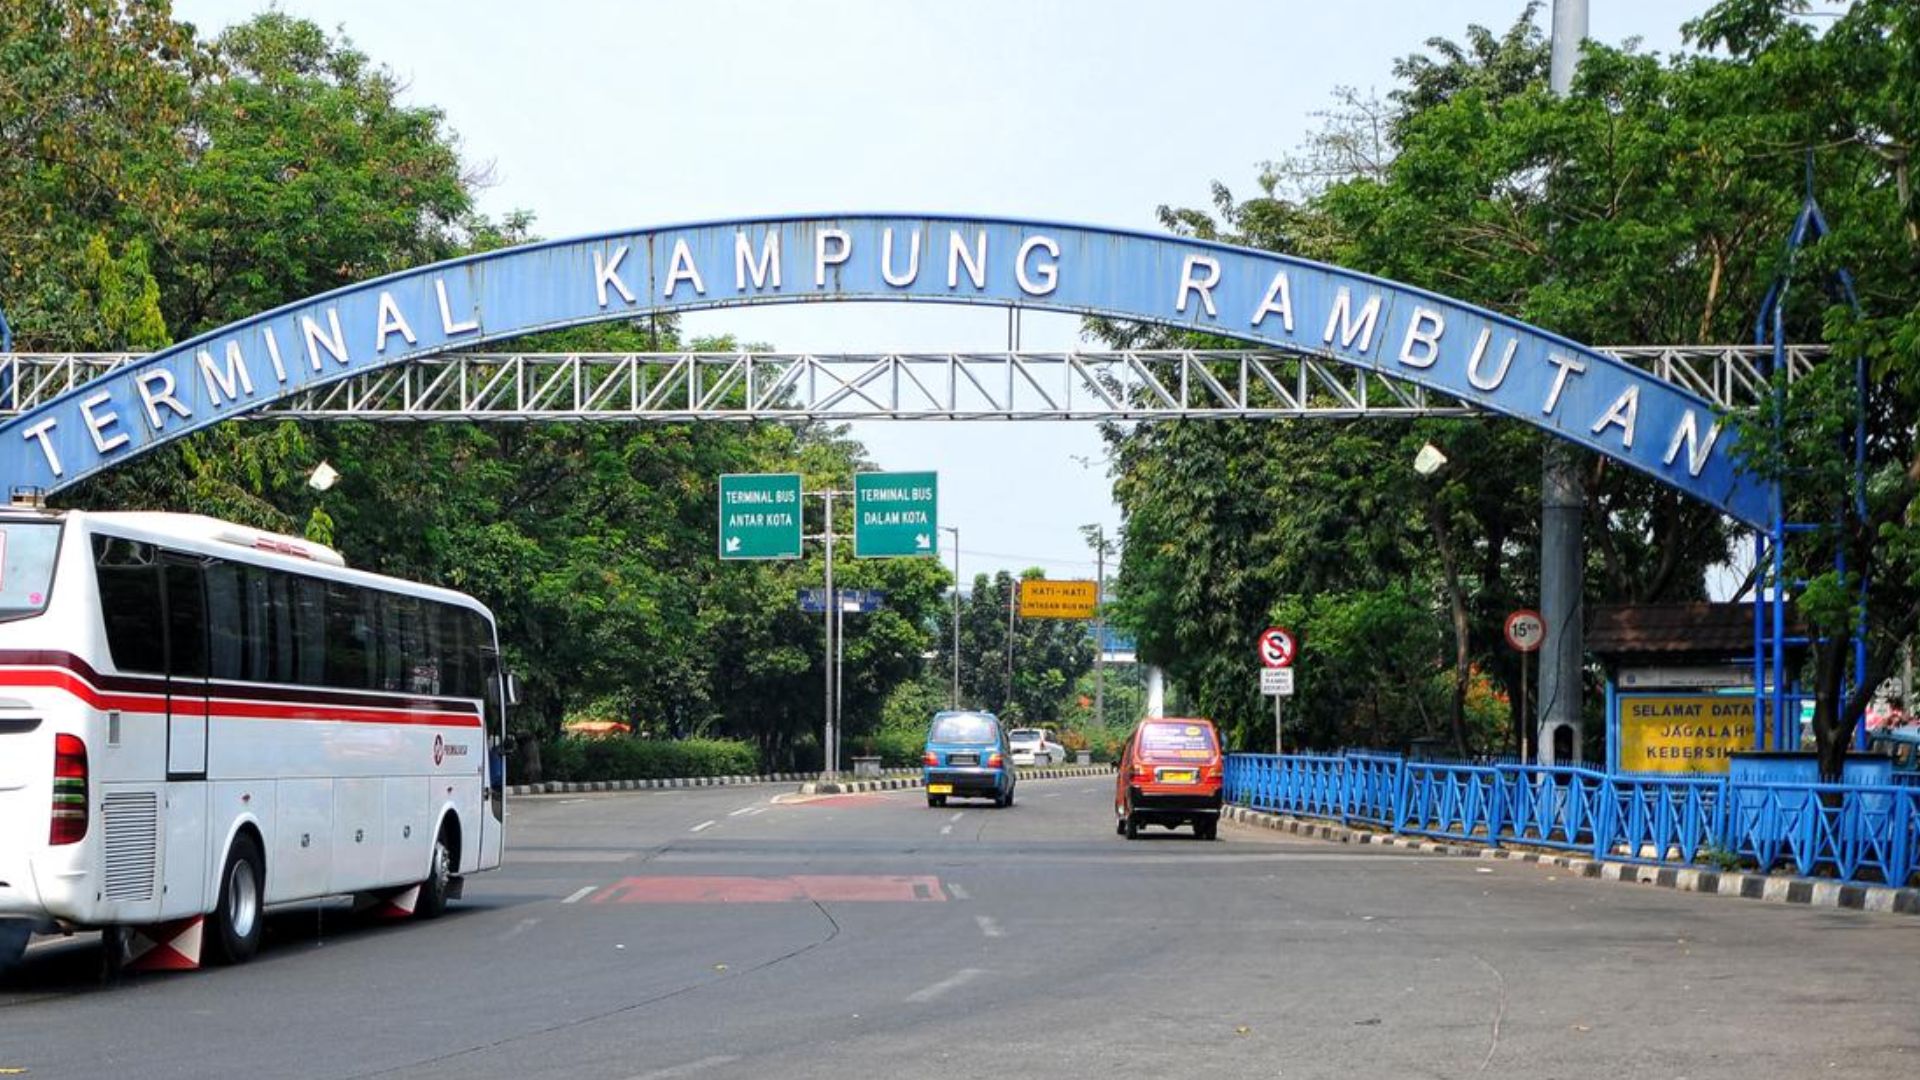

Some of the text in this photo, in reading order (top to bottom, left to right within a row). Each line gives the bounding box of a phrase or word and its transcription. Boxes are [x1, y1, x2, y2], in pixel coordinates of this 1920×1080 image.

[22, 227, 1721, 478] TERMINAL KAMPUNG RAMBUTAN
[726, 490, 796, 504] TERMINAL BUS
[861, 487, 933, 501] TERMINAL BUS
[729, 513, 793, 526] ANTAR KOTA
[864, 511, 928, 525] DALAM KOTA
[1031, 587, 1087, 596] HATI-HATI
[1632, 704, 1703, 717] SELAMAT
